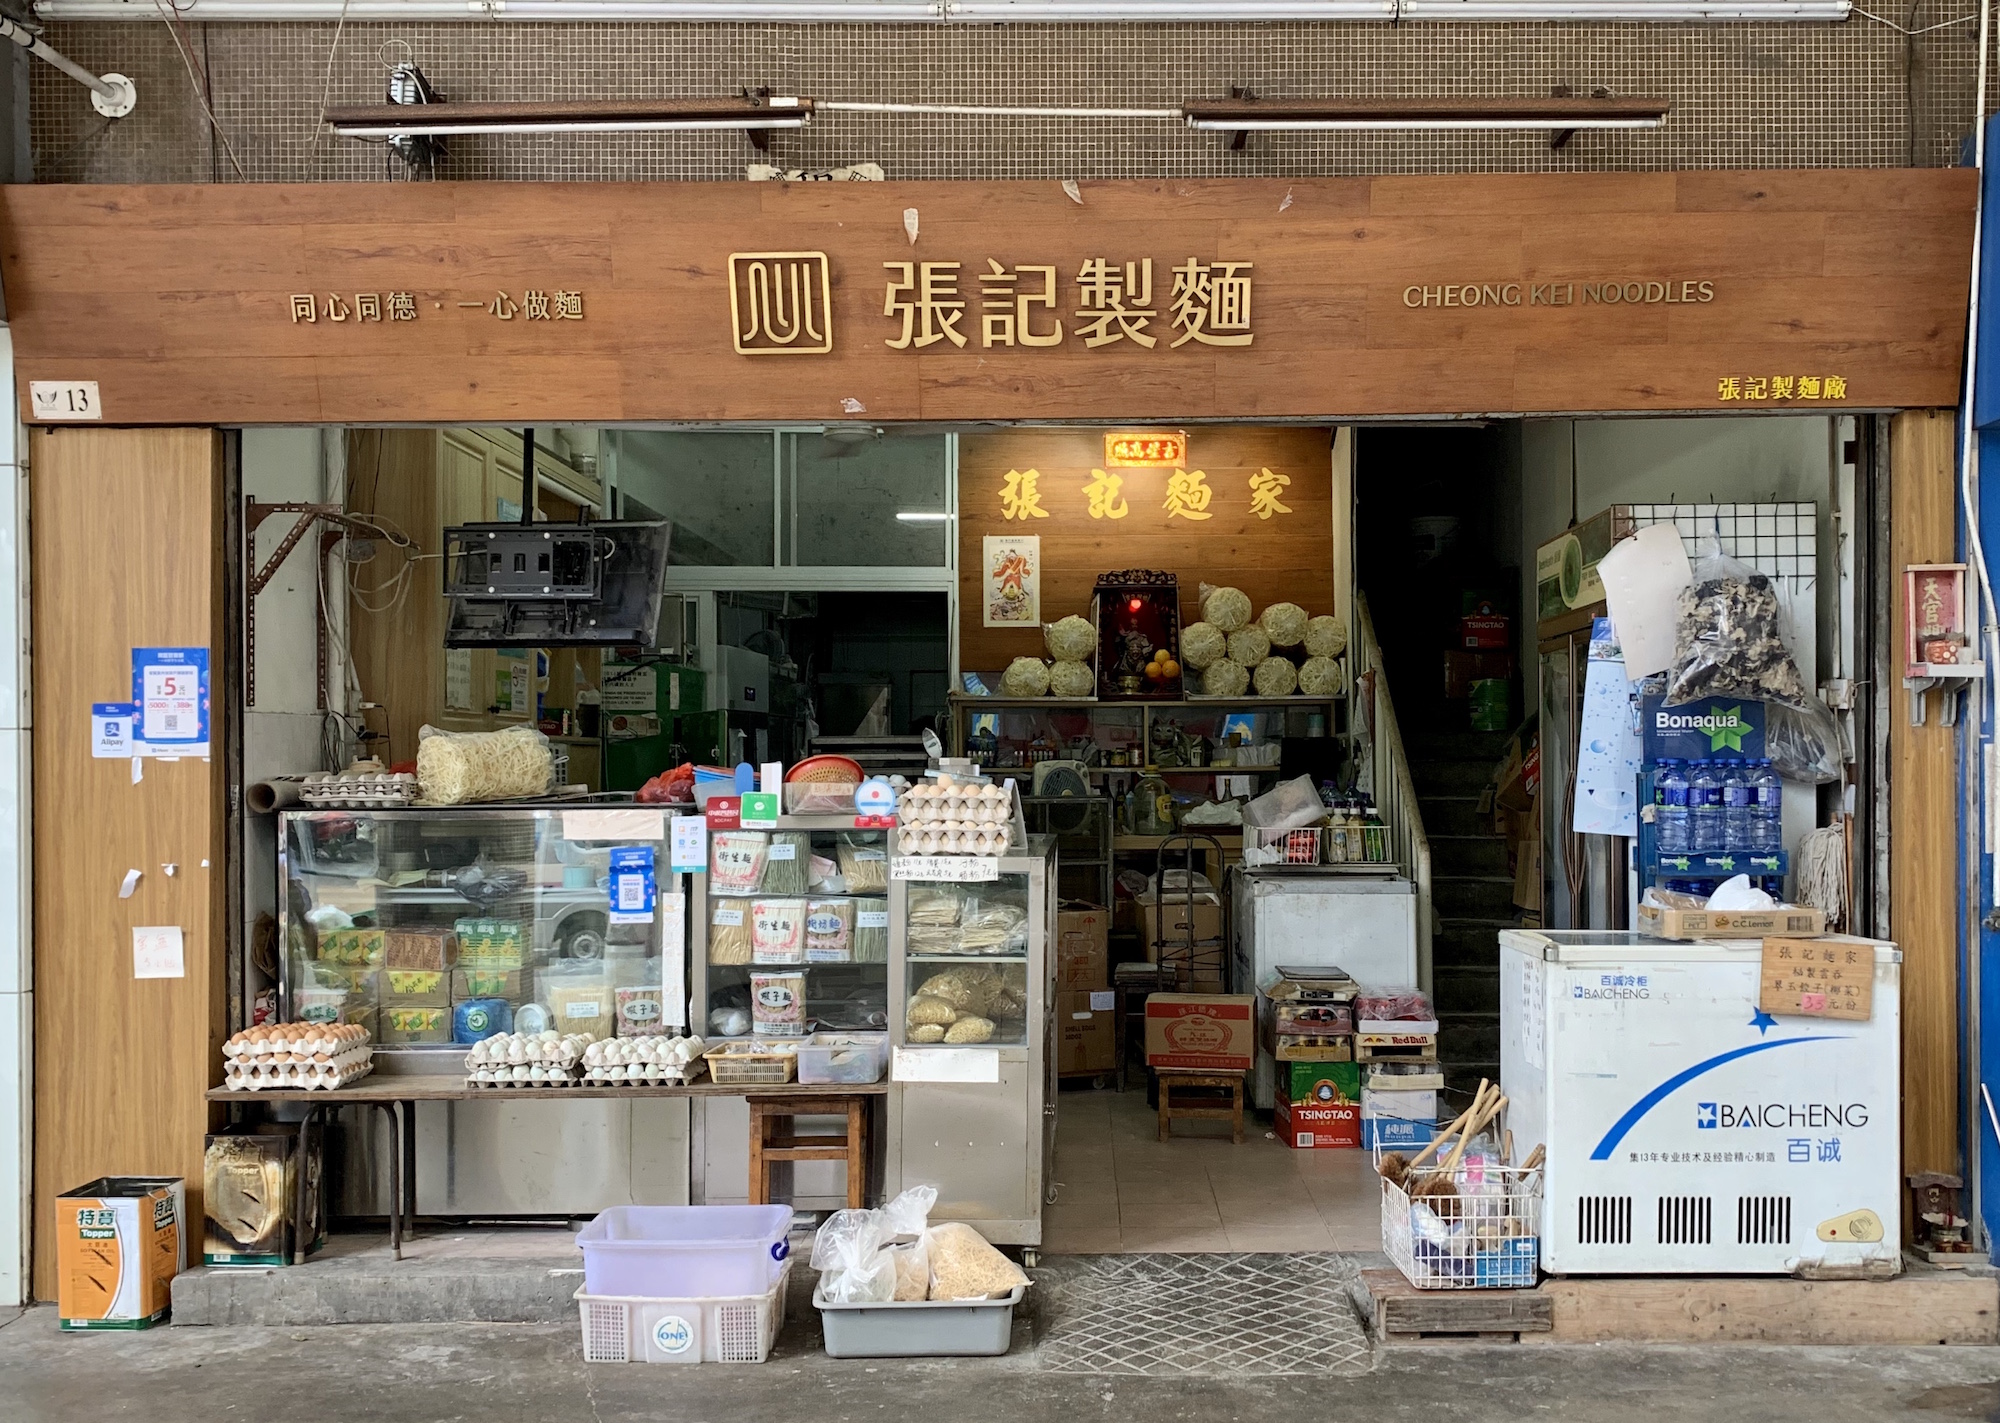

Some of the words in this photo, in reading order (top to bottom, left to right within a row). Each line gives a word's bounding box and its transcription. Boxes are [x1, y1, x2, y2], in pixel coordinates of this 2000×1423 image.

[1402, 283, 1521, 308] CHEONG
[1529, 282, 1573, 306] KEI
[1582, 280, 1715, 305] NOODLES
[882, 256, 1256, 350] 張記製麵
[1717, 375, 1848, 401] 張記製麵廠
[65, 388, 89, 412] 13
[997, 466, 1294, 522] 張記麵家
[1467, 621, 1505, 629] TSINGTAO
[164, 677, 177, 696] 5
[1655, 711, 1739, 731] Bonaqua
[101, 738, 124, 747] Alipay
[1600, 975, 1648, 987] 百诚冷柜
[1584, 987, 1650, 999] BAICHENG
[1391, 1035, 1409, 1044] Red
[1410, 1035, 1428, 1044] Bull
[1298, 1109, 1353, 1120] TSINGTAO
[1721, 1103, 1869, 1128] BAICHENG
[1629, 1151, 1776, 1164] 集13年专业技术及经验精心制造
[1786, 1137, 1841, 1163] 百诚
[78, 1209, 115, 1226] 特寶
[80, 1229, 114, 1238] Topper
[660, 1332, 686, 1341] ONE
